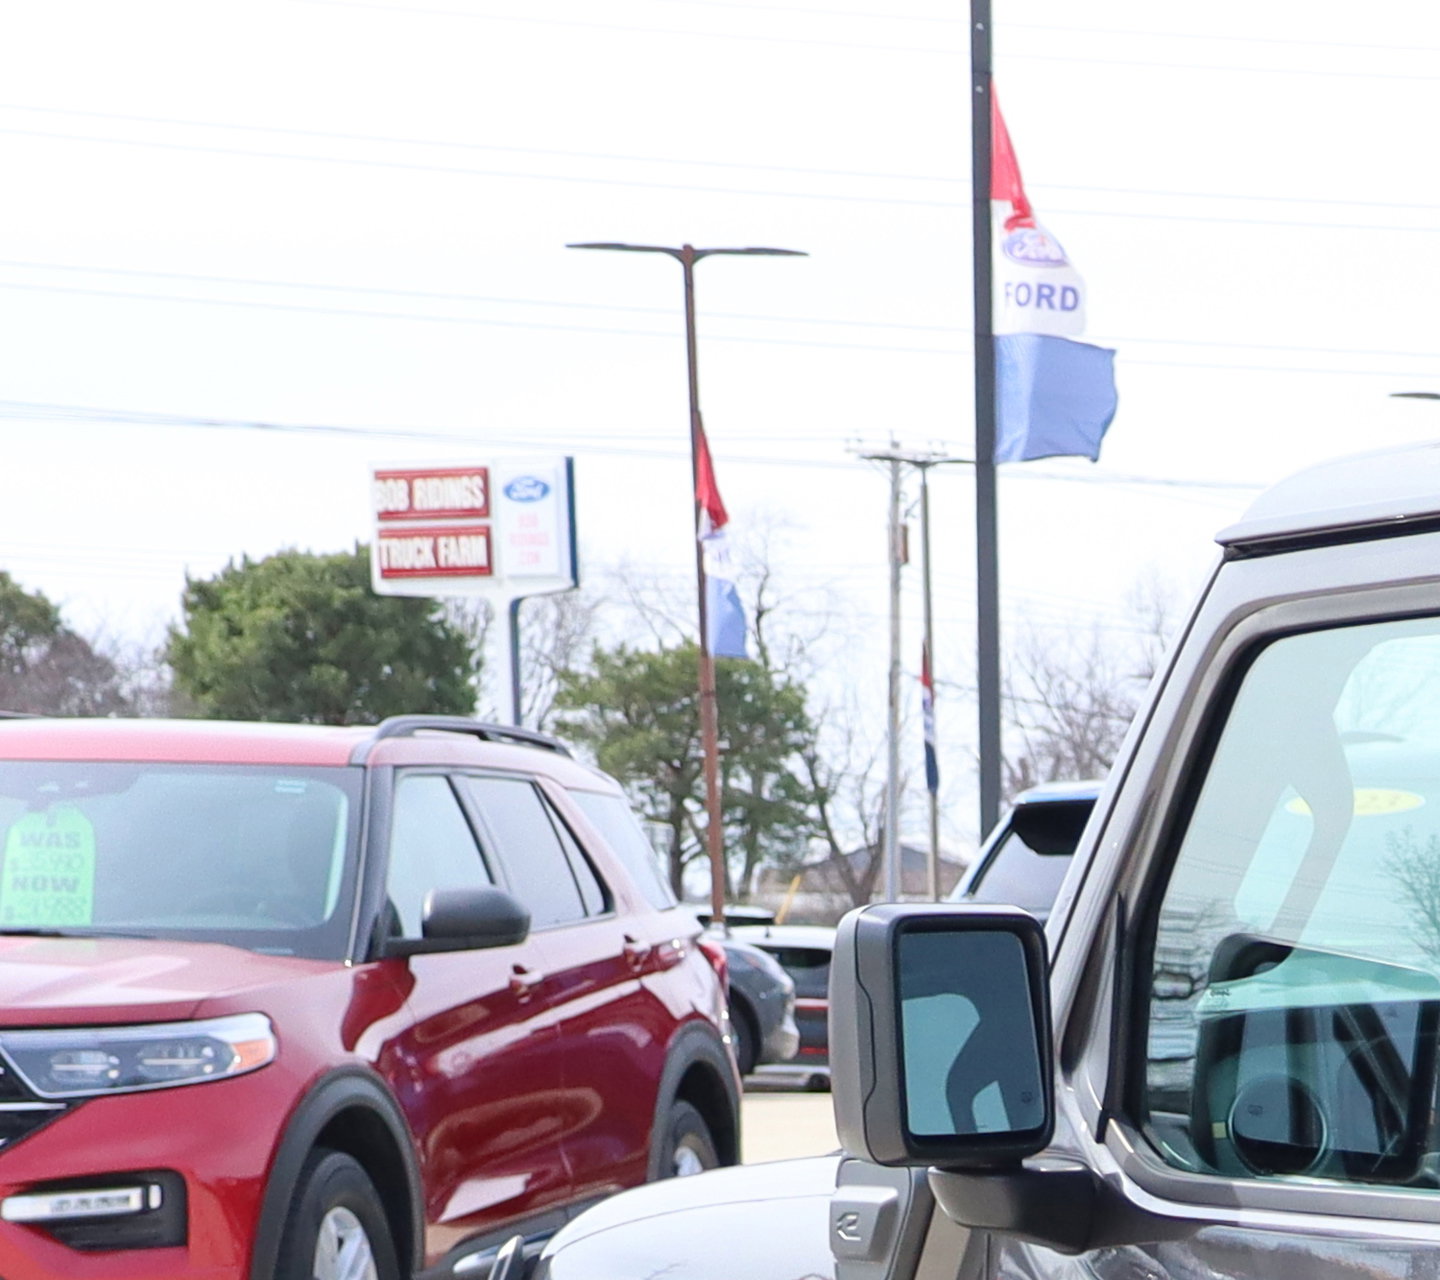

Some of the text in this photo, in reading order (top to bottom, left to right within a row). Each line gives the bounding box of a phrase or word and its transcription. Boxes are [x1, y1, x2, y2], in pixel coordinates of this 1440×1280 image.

[1004, 281, 1080, 312] FORD
[376, 474, 486, 512] BOB RIDINGS
[379, 536, 437, 570] TRUCK
[437, 533, 489, 569] FARM
